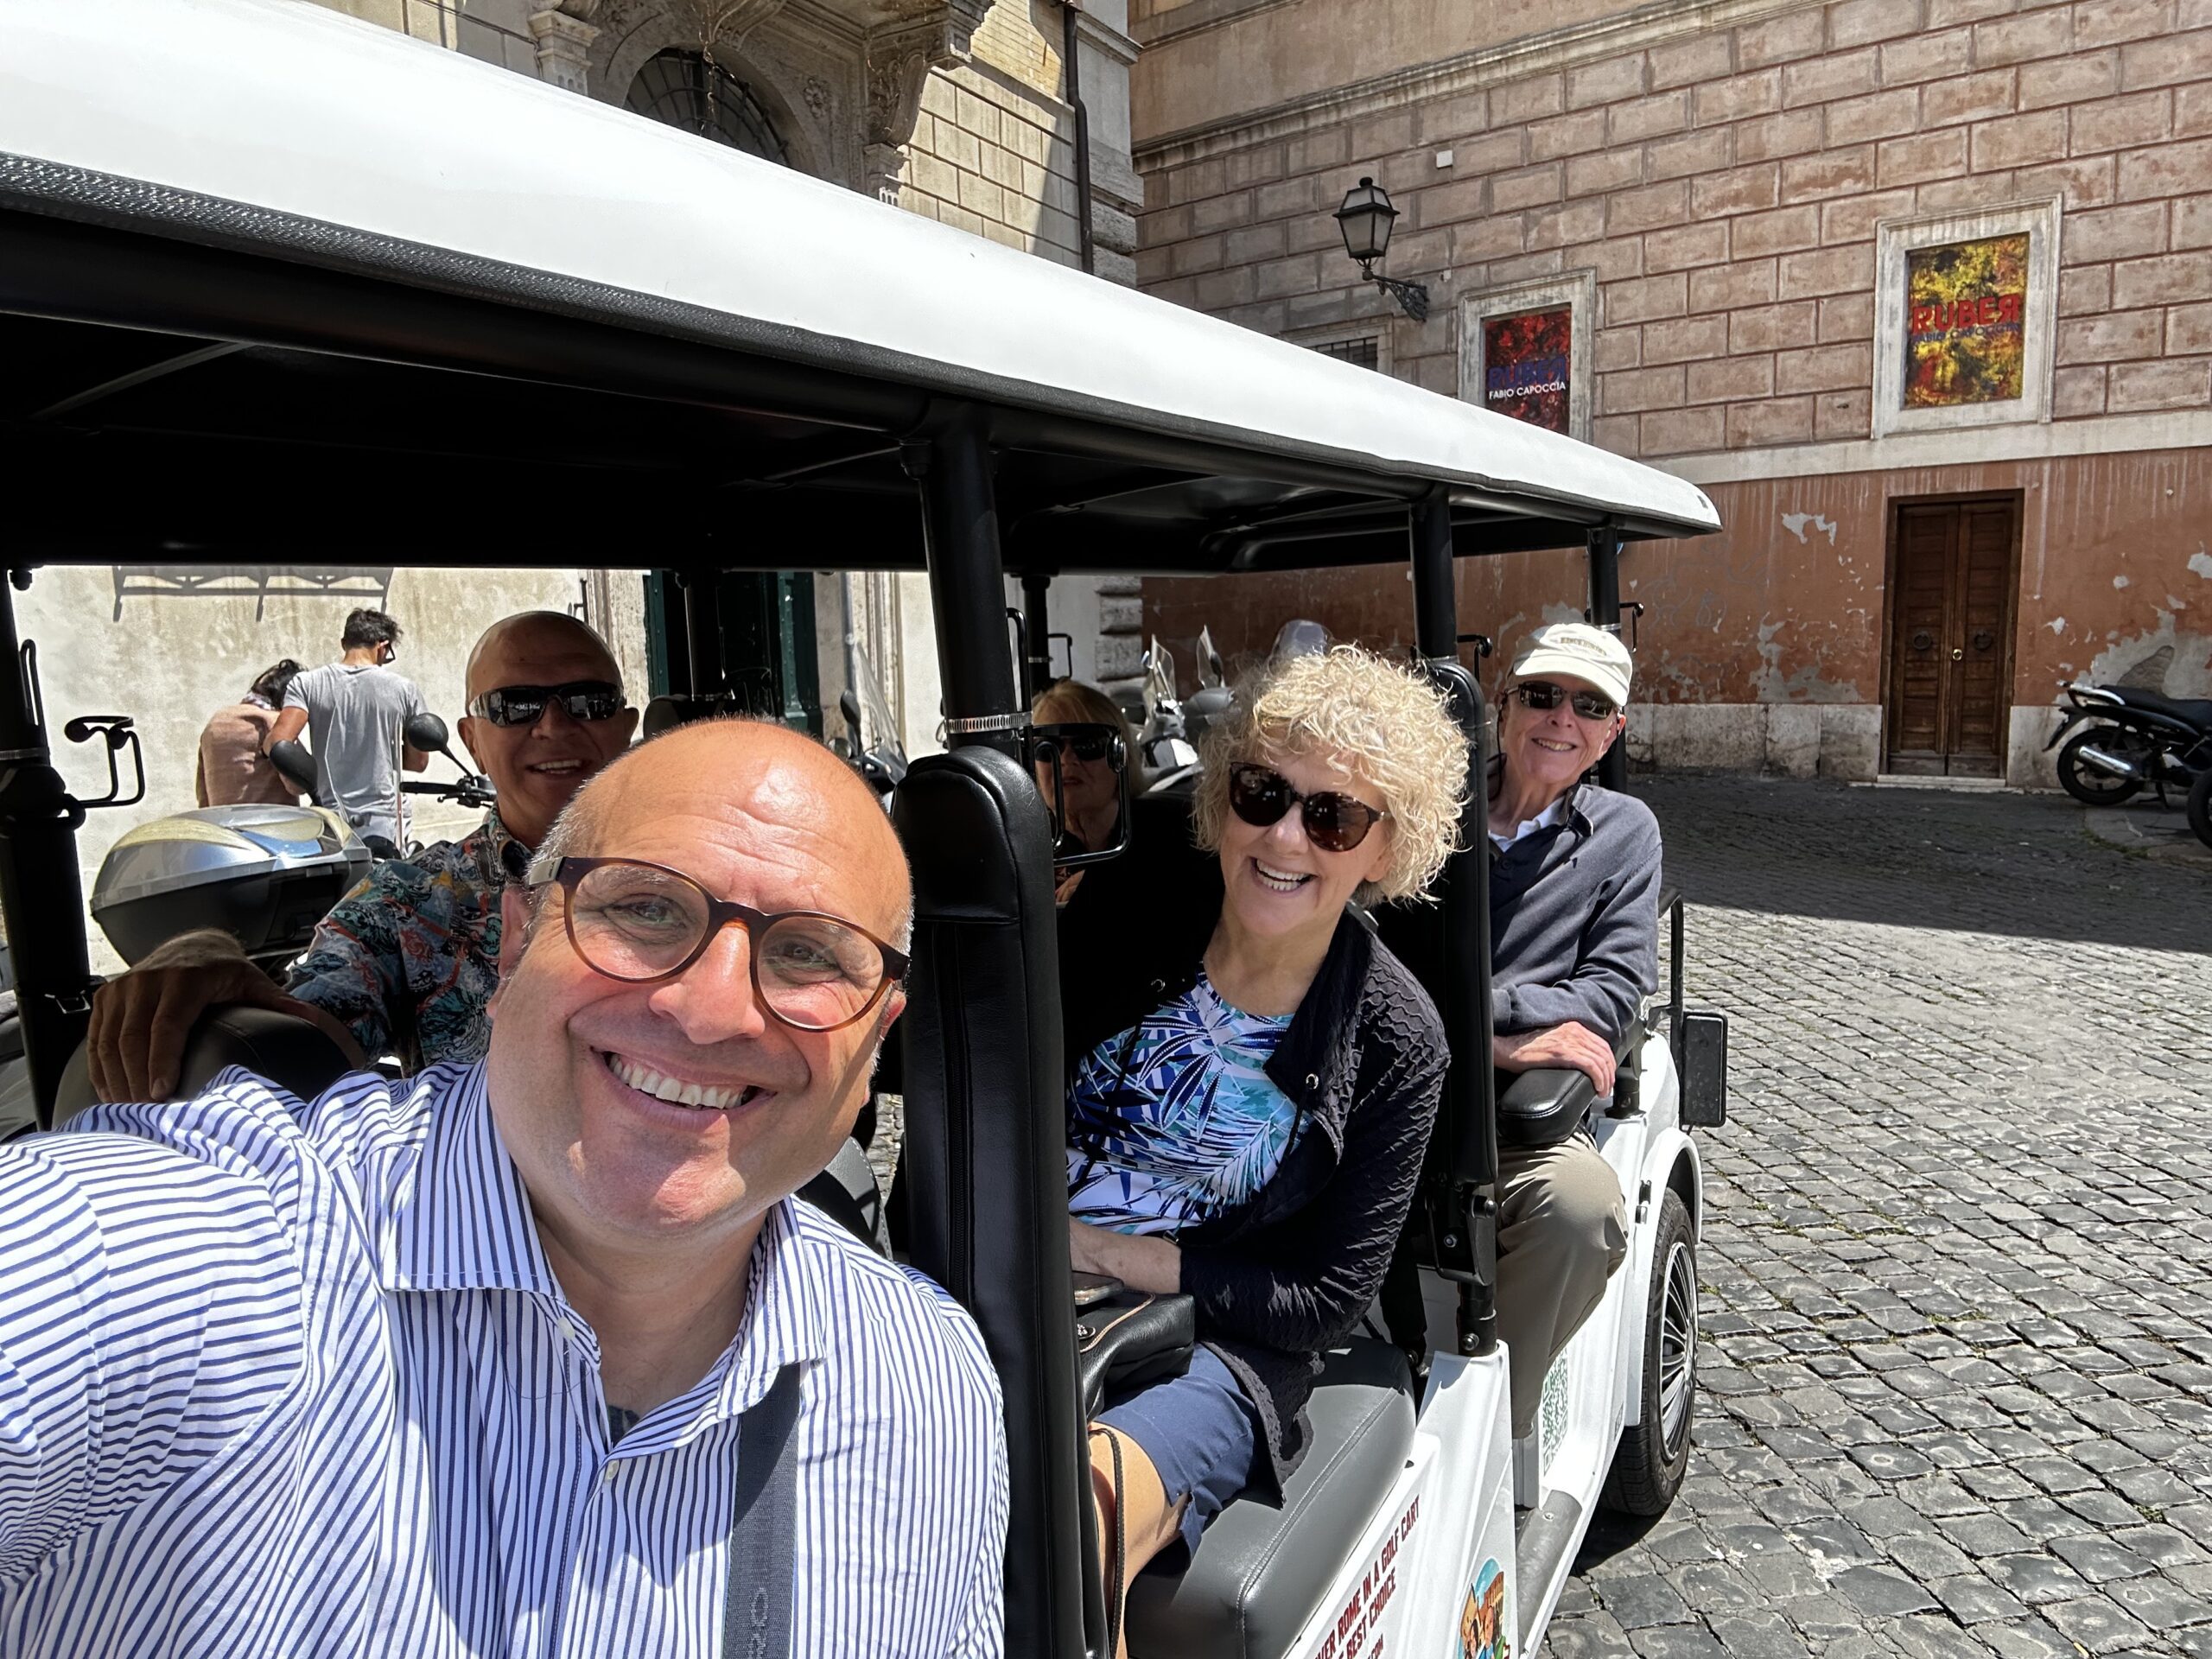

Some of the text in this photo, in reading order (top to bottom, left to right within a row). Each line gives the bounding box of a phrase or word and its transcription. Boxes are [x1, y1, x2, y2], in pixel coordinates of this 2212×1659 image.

[1489, 381, 1566, 400] FABIO CAPOCCIA
[1338, 1588, 1361, 1645] ROME
[1363, 1571, 1371, 1604] IN
[1374, 1560, 1380, 1587] A
[1382, 1527, 1398, 1573] GOLF
[1402, 1494, 1419, 1541] CART
[1346, 1567, 1395, 1659] BEST CHOICE
